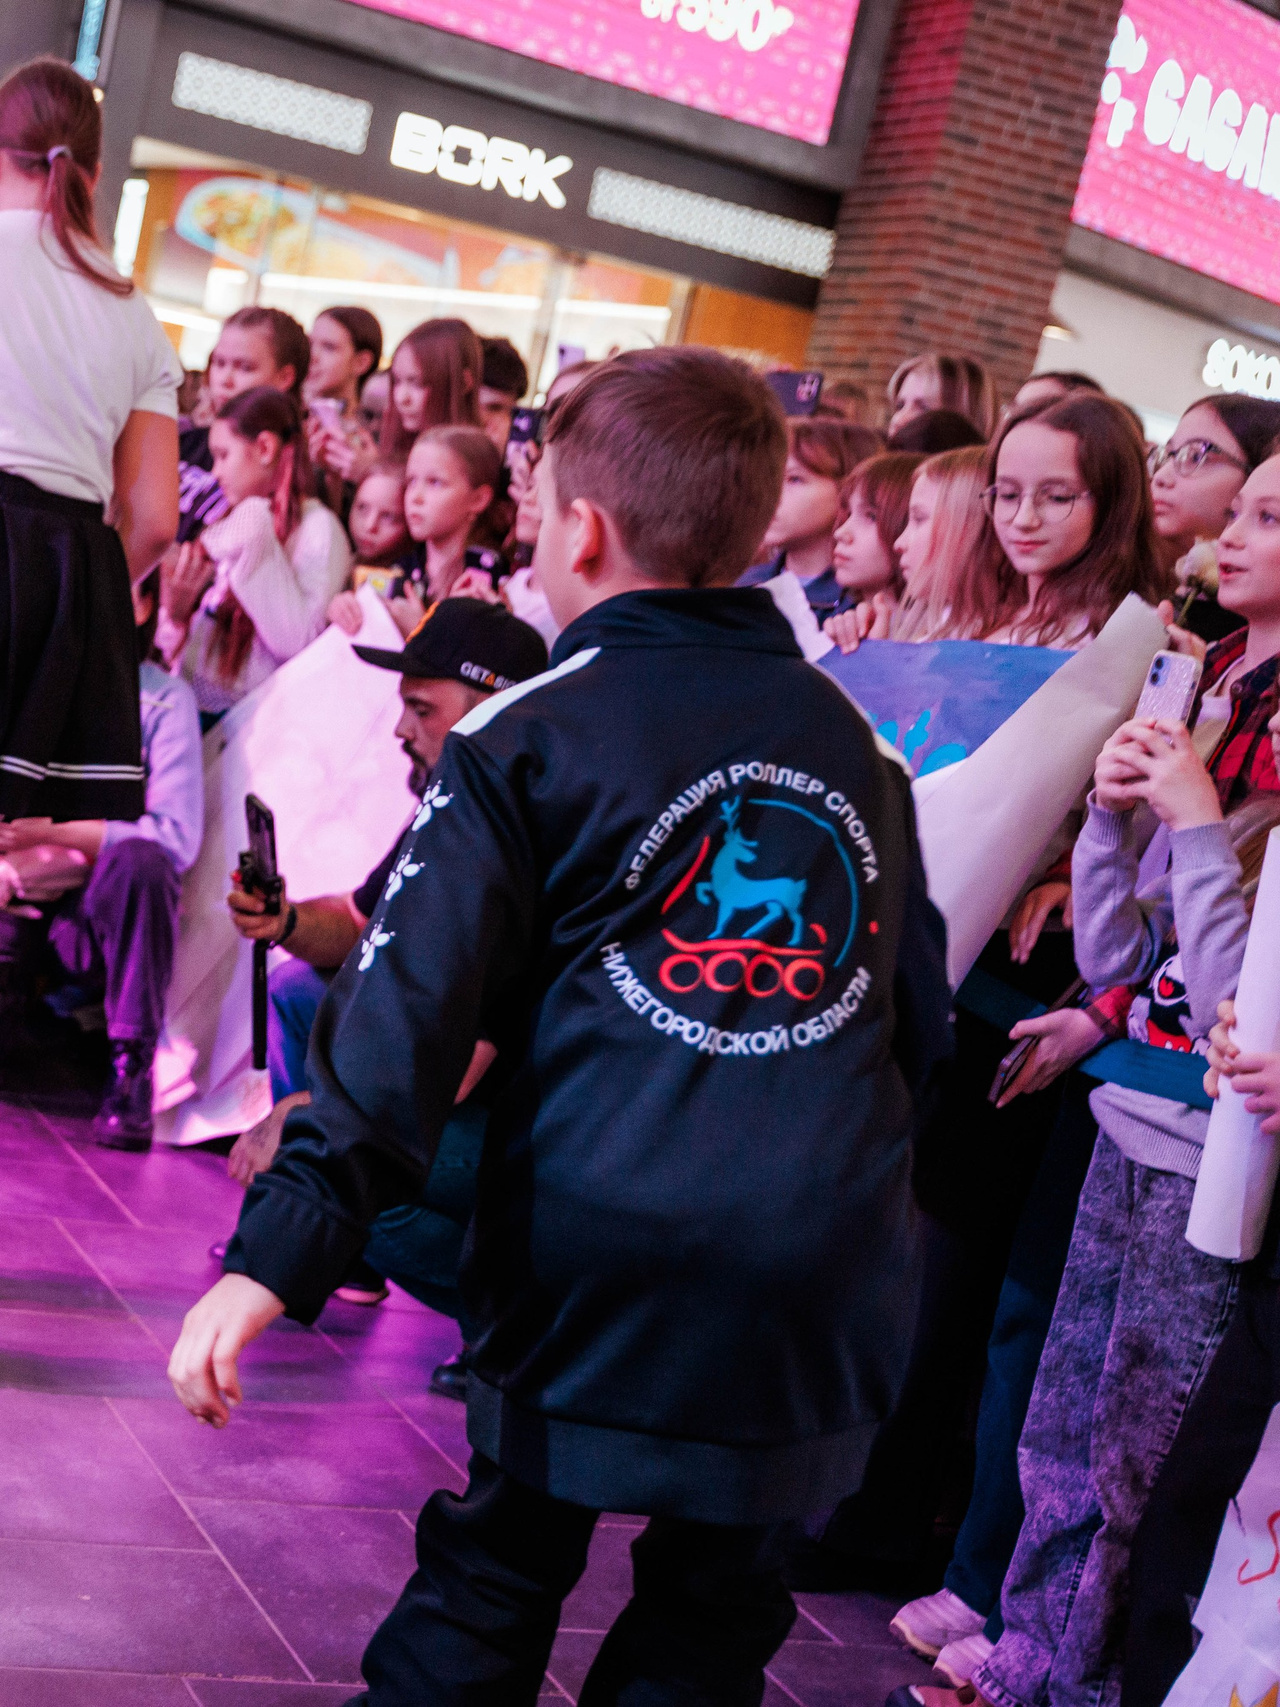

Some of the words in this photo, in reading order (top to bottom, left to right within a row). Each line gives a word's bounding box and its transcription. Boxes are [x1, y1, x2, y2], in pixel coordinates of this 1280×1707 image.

[390, 111, 574, 210] BORK
[624, 769, 727, 891] ФЕДЕРАЦИЯ
[728, 760, 826, 796] РОЛЛЕР
[824, 790, 880, 884] СПОРТА
[599, 941, 790, 1056] НИЖЕГОРОДСКОЙ
[792, 965, 872, 1047] ОБЛАСТИ
